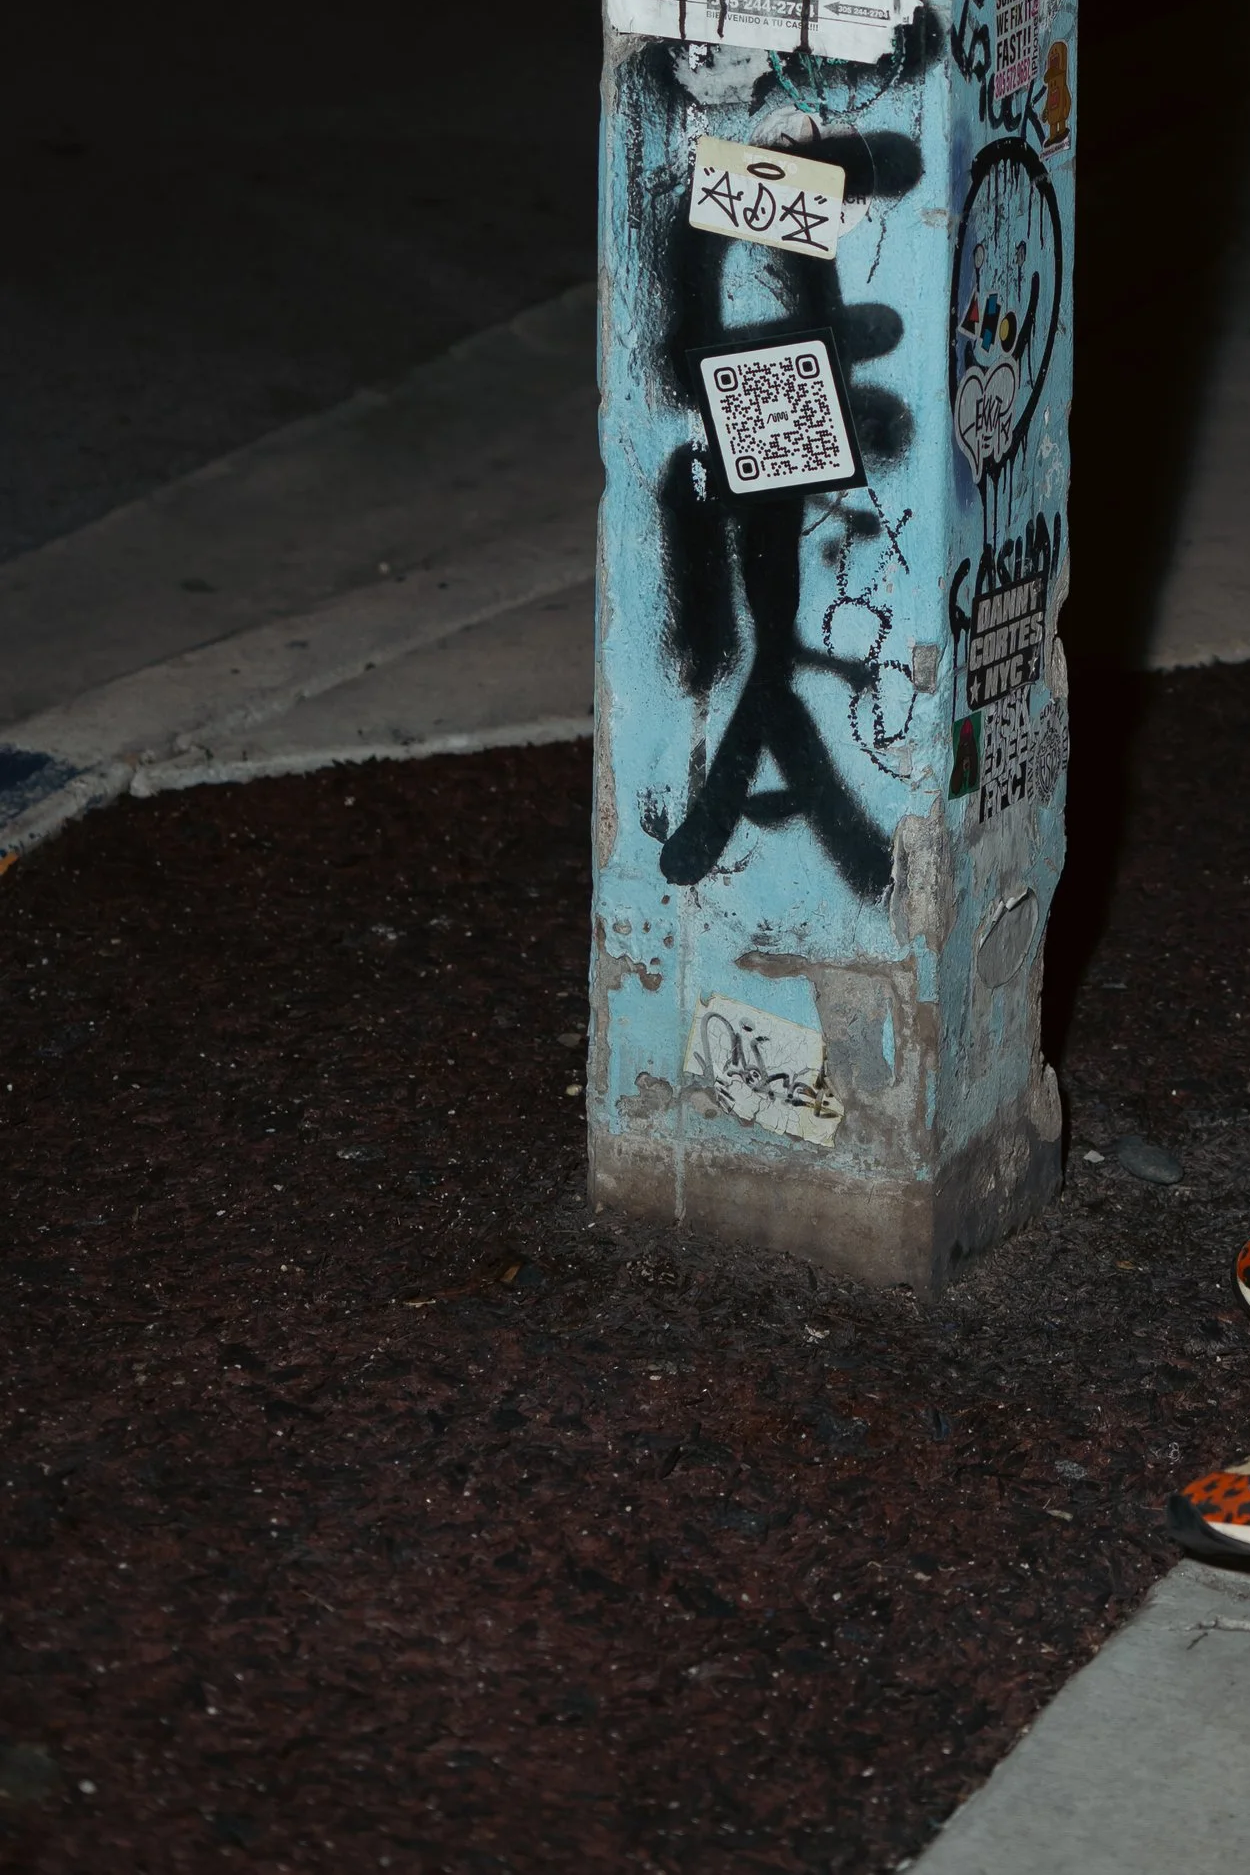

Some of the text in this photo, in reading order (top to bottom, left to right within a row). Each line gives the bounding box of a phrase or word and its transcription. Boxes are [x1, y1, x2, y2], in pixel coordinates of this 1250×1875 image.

[996, 12, 1009, 38] WE
[1010, 4, 1024, 31] FIX
[996, 28, 1032, 71] FAST!!
[976, 580, 1039, 635] DANNY
[969, 611, 1044, 673] CORTES
[984, 656, 1024, 701] NYC
